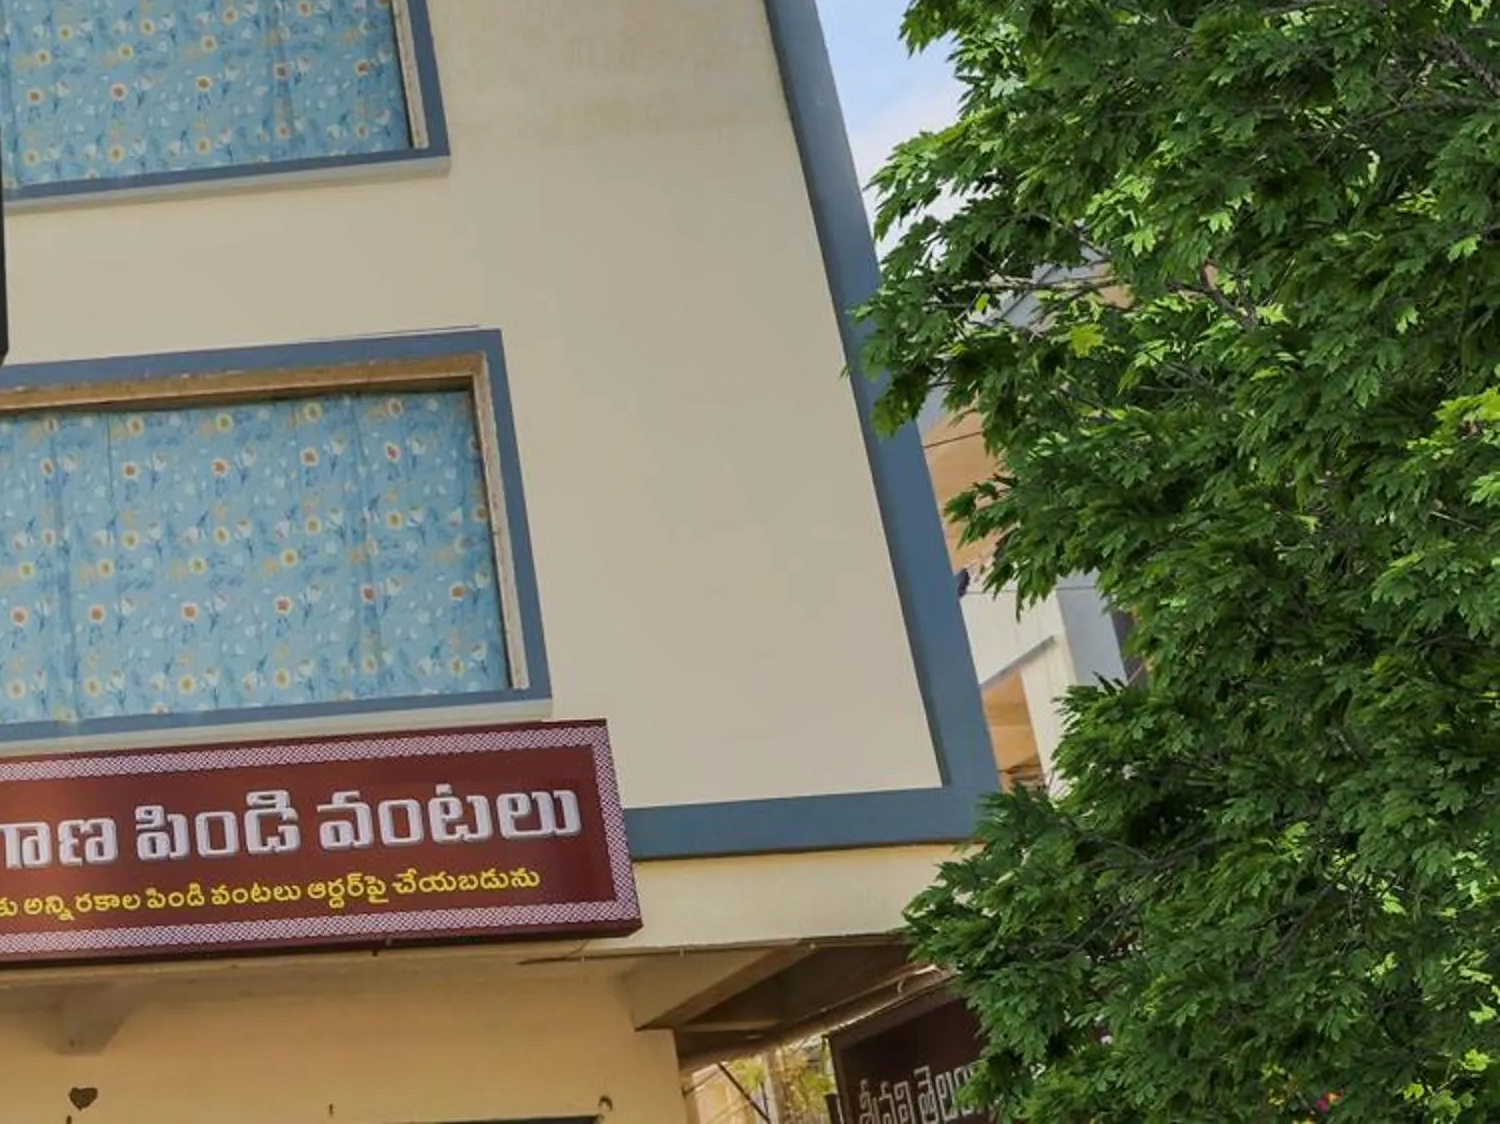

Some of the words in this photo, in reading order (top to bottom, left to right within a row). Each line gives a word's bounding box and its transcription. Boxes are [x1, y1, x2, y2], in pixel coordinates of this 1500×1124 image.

[134, 788, 301, 863] పిండి
[315, 782, 585, 854] వంటలు
[23, 892, 75, 923] అన్ని
[74, 890, 142, 913] రకాల
[145, 882, 206, 910] పిండి
[211, 881, 302, 906] వంటలు
